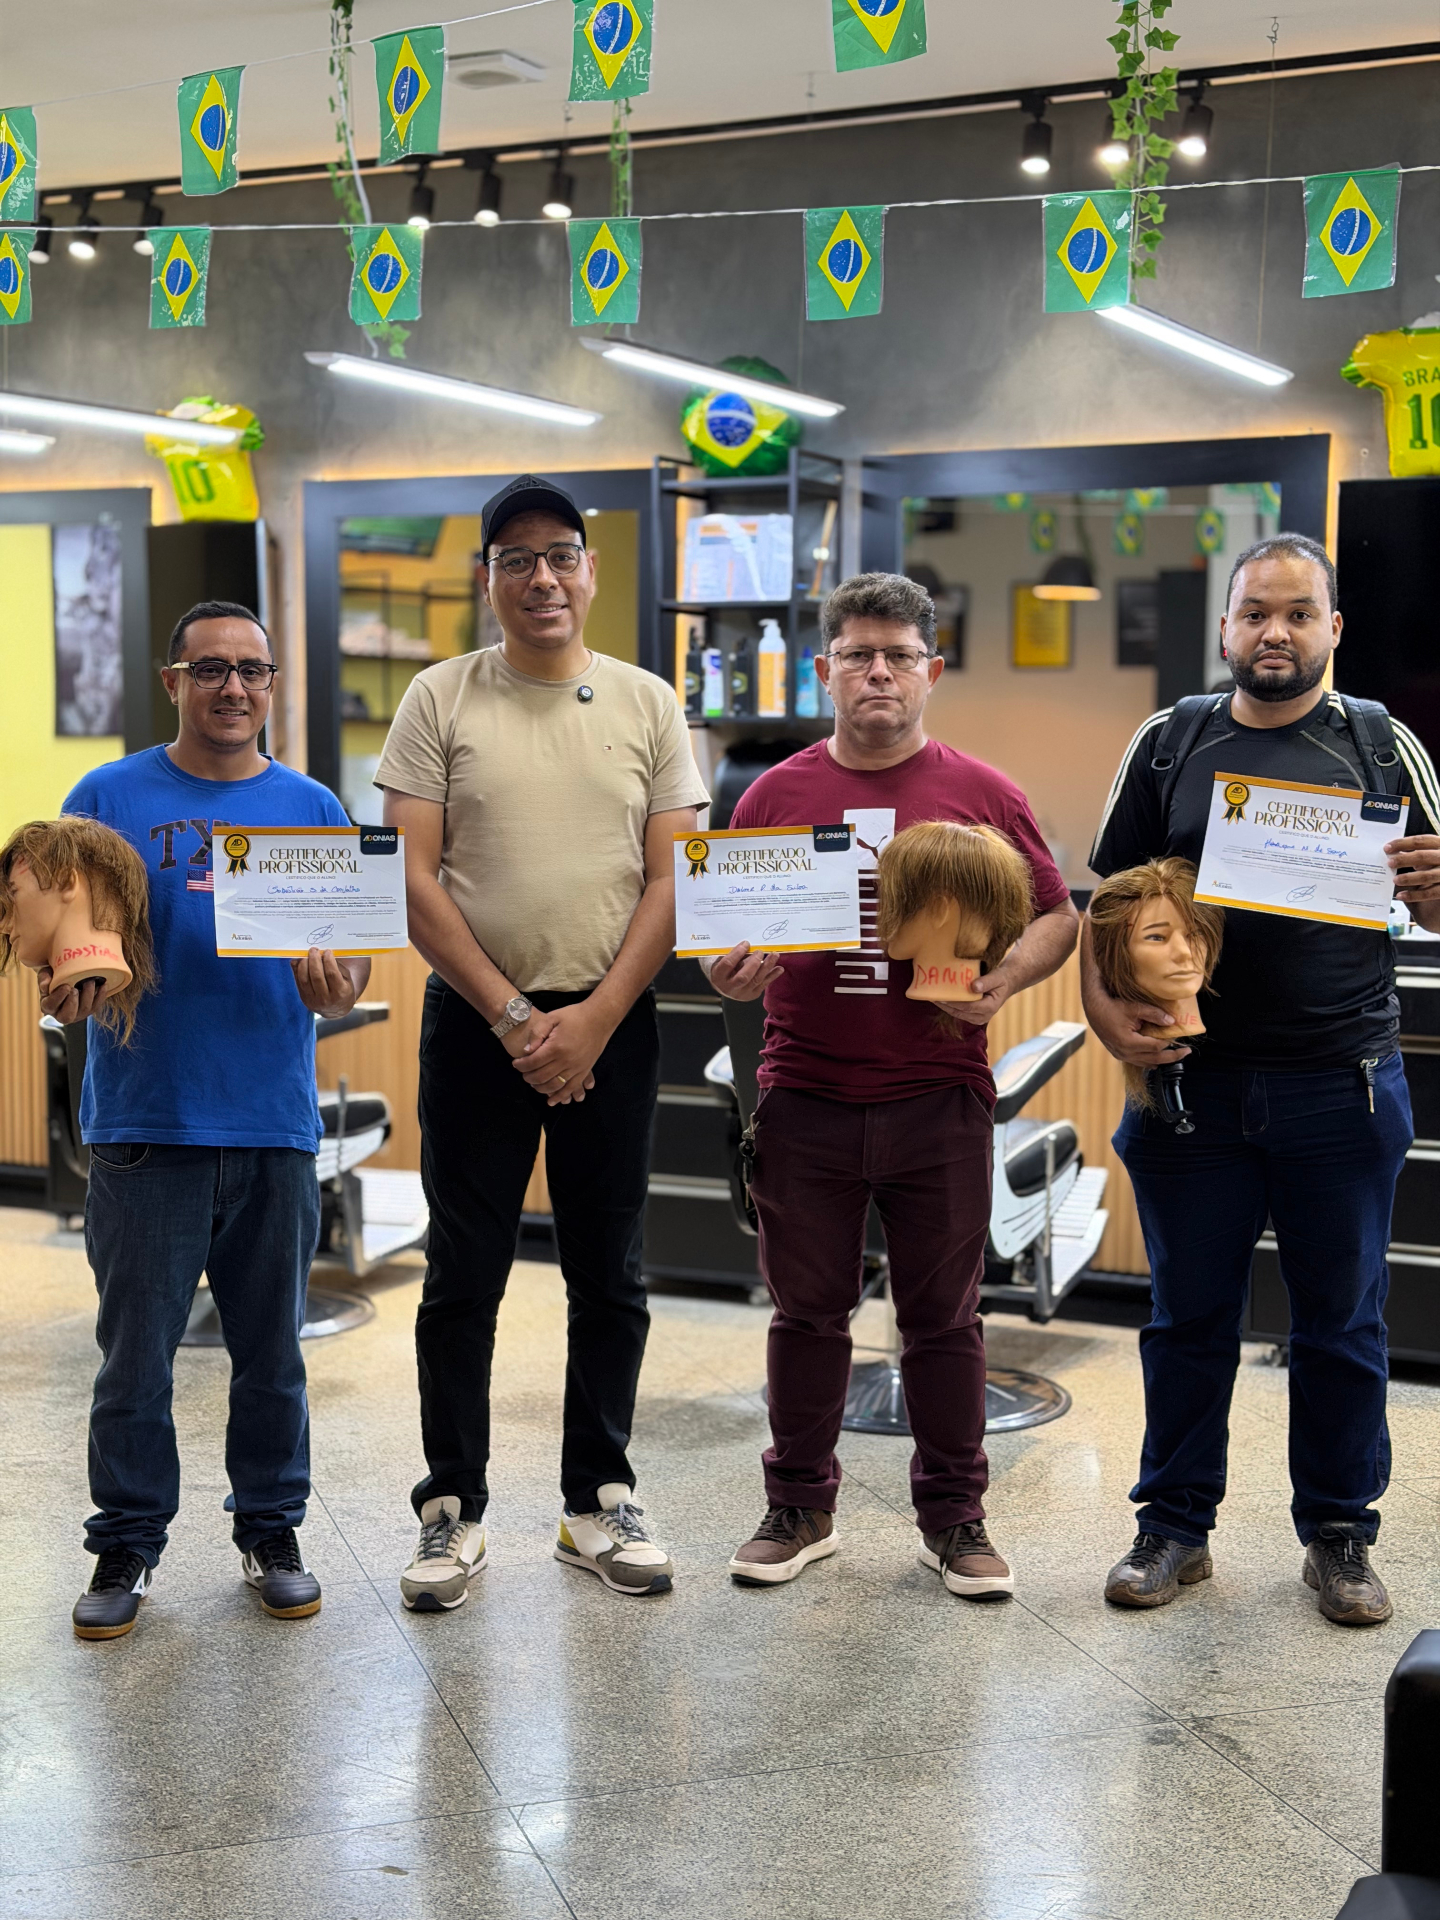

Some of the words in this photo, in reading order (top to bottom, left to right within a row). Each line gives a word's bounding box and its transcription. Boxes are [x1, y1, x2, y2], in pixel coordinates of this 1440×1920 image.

[1267, 801, 1351, 822] CERTIFICADO
[1253, 811, 1359, 838] PROFISSIONAL
[362, 834, 396, 842] ADONIAS
[269, 848, 352, 860] CERTIFICADO
[728, 847, 806, 862] CERTIFICADO
[258, 860, 363, 874] PROFISSIONAL
[717, 858, 817, 875] PROFISSIONAL
